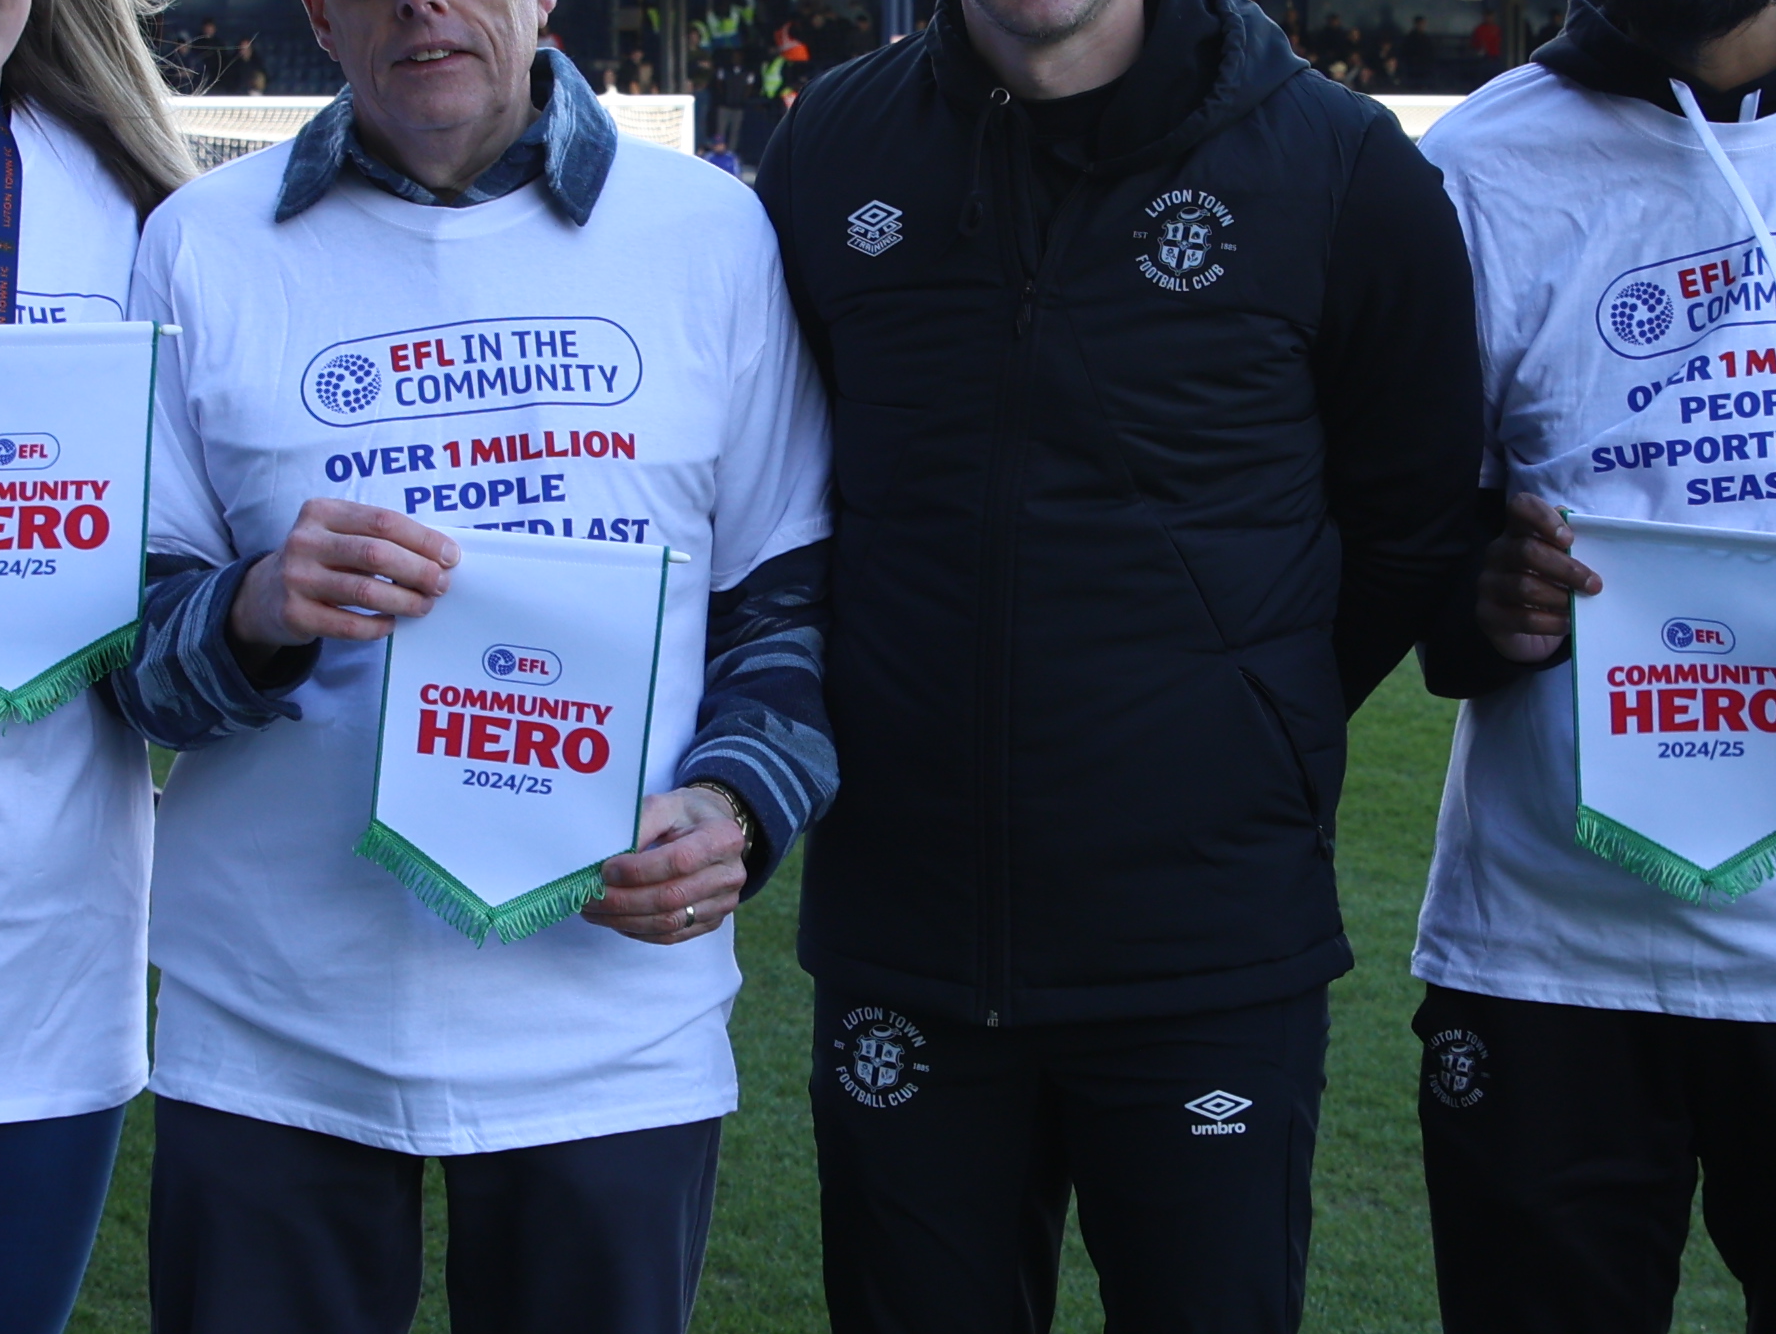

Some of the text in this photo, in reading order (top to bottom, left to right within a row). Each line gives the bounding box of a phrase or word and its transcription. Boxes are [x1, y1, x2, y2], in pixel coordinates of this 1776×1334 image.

[1144, 189, 1235, 227] LUTON TOWN
[852, 224, 898, 240] PRO
[853, 235, 898, 253] TRAINING
[1133, 230, 1237, 252] EST 1885
[1135, 254, 1225, 292] FOOTBALL CLUB
[1678, 260, 1737, 300] EFL
[389, 330, 579, 373] EFL IN THE
[1719, 351, 1736, 378] 1
[395, 364, 618, 407] COMMUNITY
[18, 442, 48, 460] EFL
[325, 431, 635, 482] OVER 1 MILLION
[404, 474, 566, 514] PEOPLE
[1694, 628, 1725, 646] EFL
[517, 656, 550, 676] EFL
[420, 683, 613, 726] COMMUNITY
[417, 708, 610, 775] HERO
[1657, 740, 1745, 761] 2024/25
[463, 769, 553, 795] 2024/25
[842, 1006, 927, 1048] LUTON TOWN
[1428, 1029, 1489, 1060] LUTON TOWN
[835, 1066, 919, 1108] FOOTBALL CLUB
[1428, 1074, 1484, 1109] FOOTBALL CLUB
[1191, 1121, 1247, 1137] umbro
